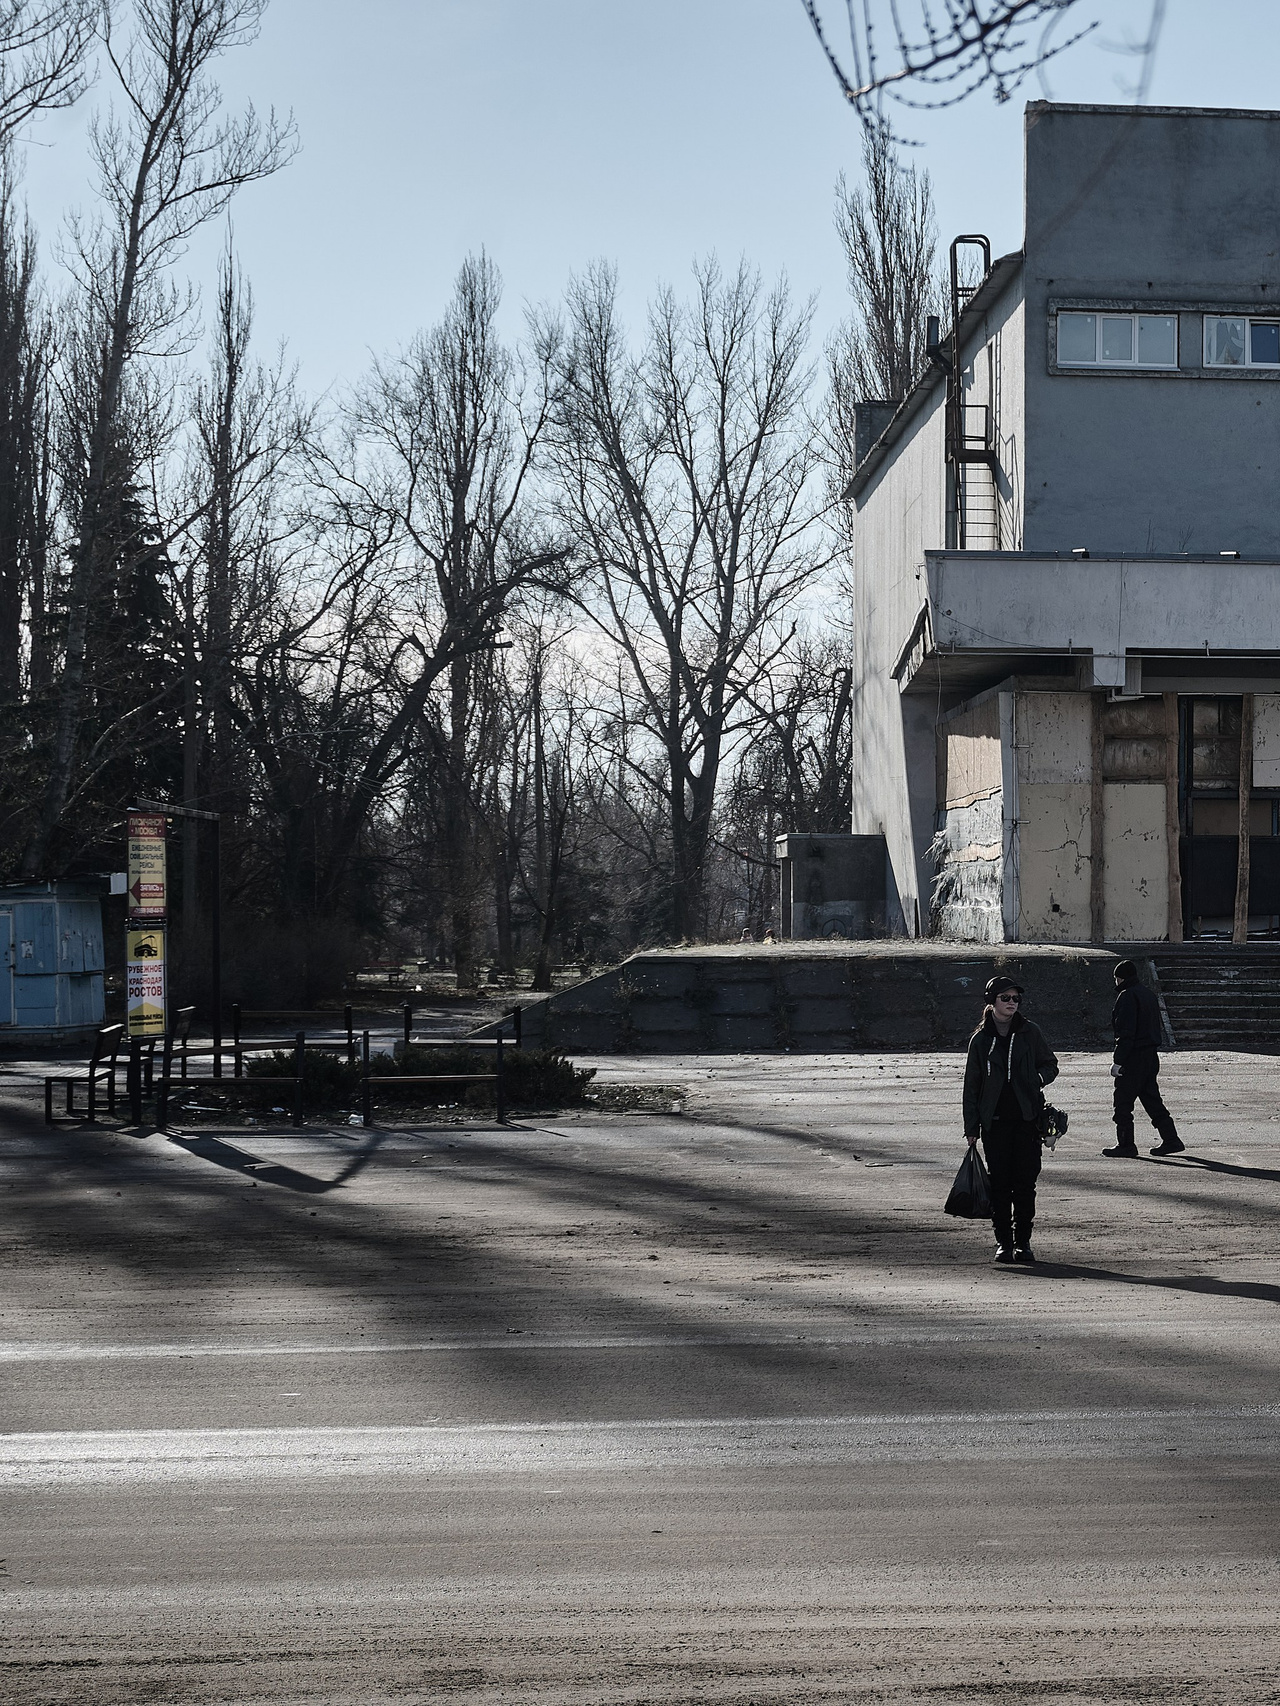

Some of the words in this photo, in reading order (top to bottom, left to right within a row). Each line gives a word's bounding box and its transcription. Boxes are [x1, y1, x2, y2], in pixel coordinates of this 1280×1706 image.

[134, 827, 158, 835] МОСКВА
[131, 844, 162, 852] ЕЖЕДНЕВНЫЕ
[128, 964, 162, 973] РУБЕЖНОЕ
[129, 977, 162, 985] КРАСНОДАР
[129, 986, 162, 998] РОСТОВ
